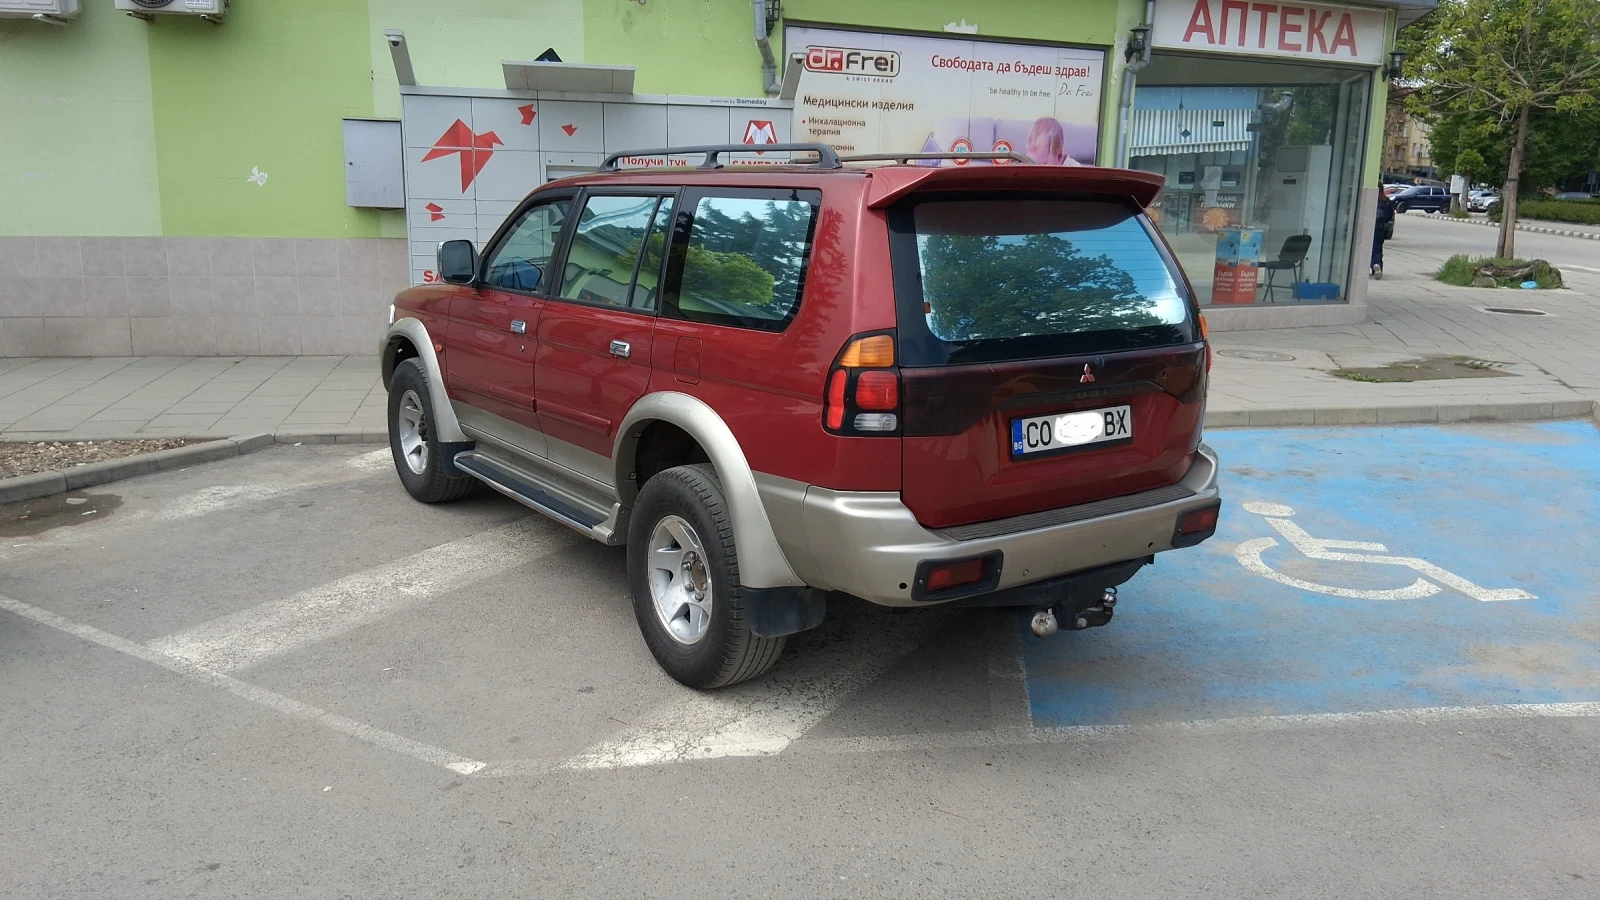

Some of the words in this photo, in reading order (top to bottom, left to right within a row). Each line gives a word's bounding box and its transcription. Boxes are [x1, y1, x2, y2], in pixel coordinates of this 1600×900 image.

[1182, 0, 1358, 56] АПТЕКА
[931, 55, 994, 72] Свободата
[996, 62, 1011, 74] да
[1014, 61, 1052, 76] бъдеш
[1055, 66, 1090, 79] здрав!
[998, 87, 1021, 97] healthy
[1029, 89, 1038, 97] be
[736, 98, 767, 106] Sameday
[803, 95, 869, 109] Медицински
[871, 100, 914, 111] изделия
[808, 116, 866, 127] Инхалационна
[808, 127, 841, 137] терапия
[622, 156, 664, 167] Получи
[1013, 441, 1023, 451] BG
[1026, 421, 1052, 448] CO
[1103, 409, 1127, 437] BX
